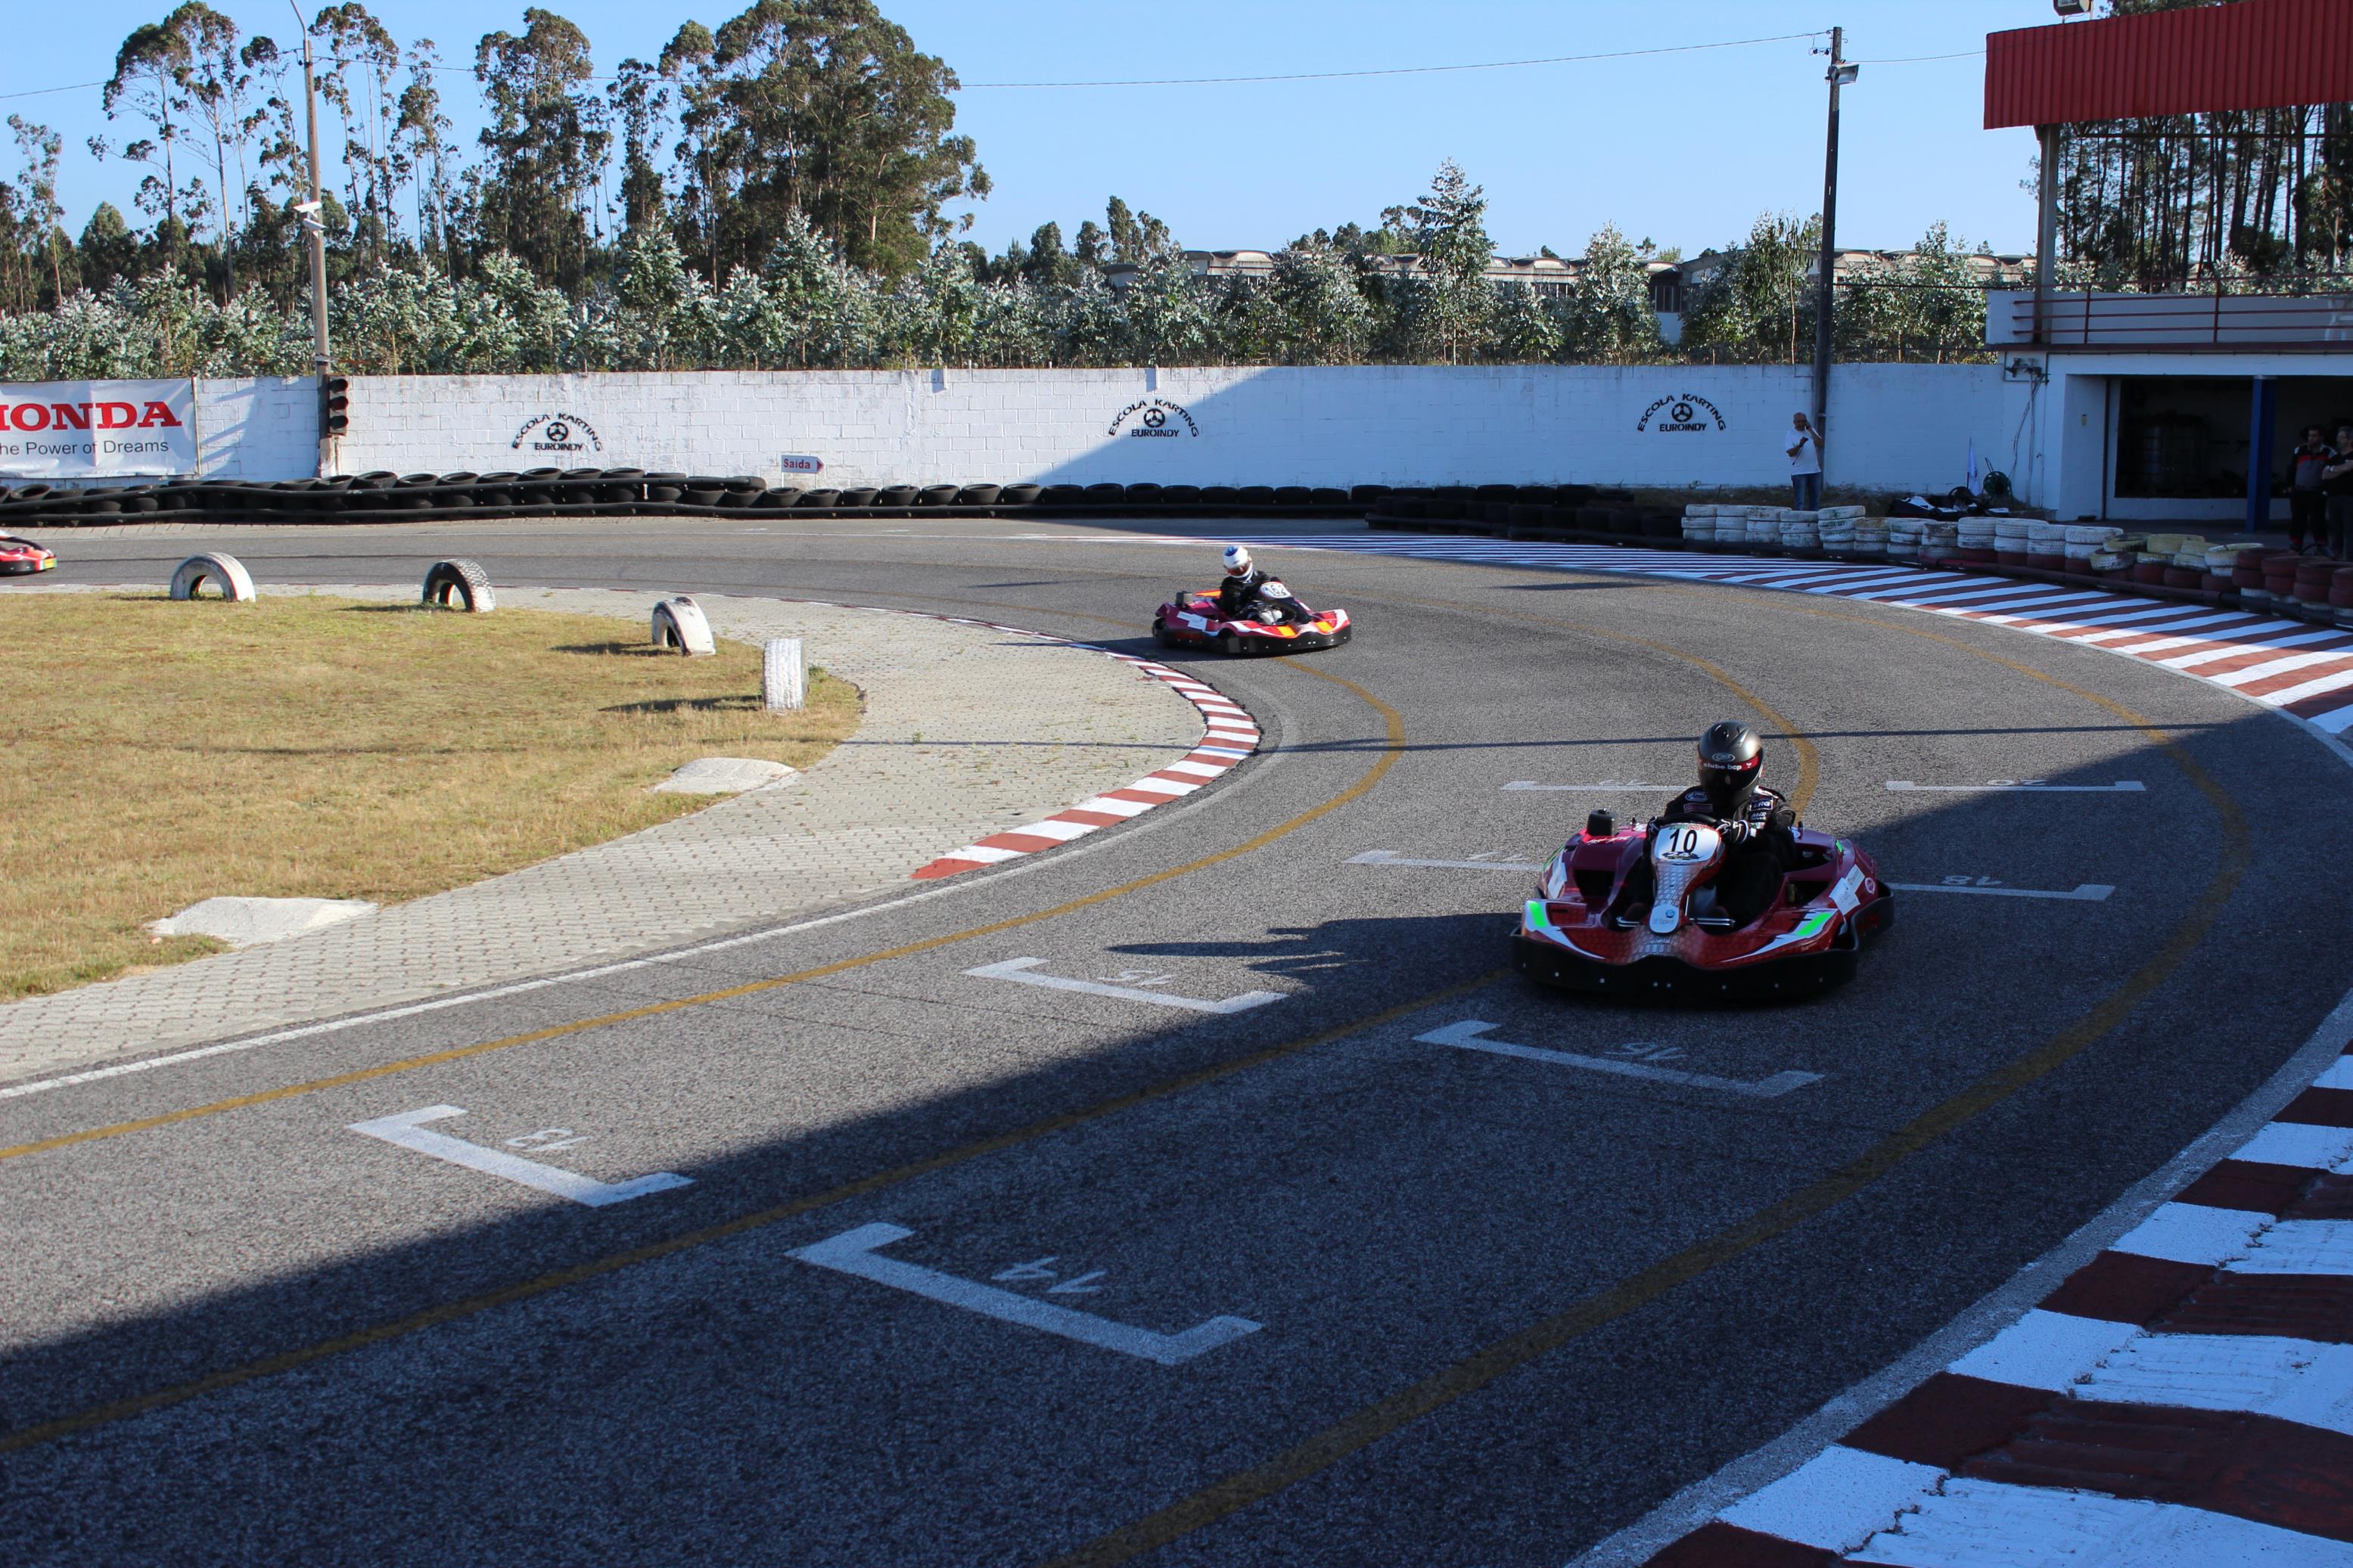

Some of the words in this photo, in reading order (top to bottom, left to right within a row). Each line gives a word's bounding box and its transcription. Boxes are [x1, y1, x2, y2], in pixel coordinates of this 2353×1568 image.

[1108, 400, 1147, 436] ESCOLA
[1155, 399, 1199, 437] KARTING
[1637, 395, 1675, 432] ESCOLA
[1682, 393, 1726, 430] KARTING
[512, 414, 551, 449] ESCOLA
[558, 413, 603, 452] KARTING
[1131, 429, 1180, 437] EUROINDY
[26, 442, 78, 455] Power
[82, 442, 98, 453] of
[104, 440, 169, 453] Dreams
[534, 442, 583, 451] EUROINDY
[1670, 828, 1698, 853] 10
[1940, 874, 2004, 886] 18
[1096, 969, 1176, 986] 15
[1603, 1042, 1686, 1060] 16
[505, 1128, 593, 1153] 13
[992, 1256, 1108, 1293] 14
